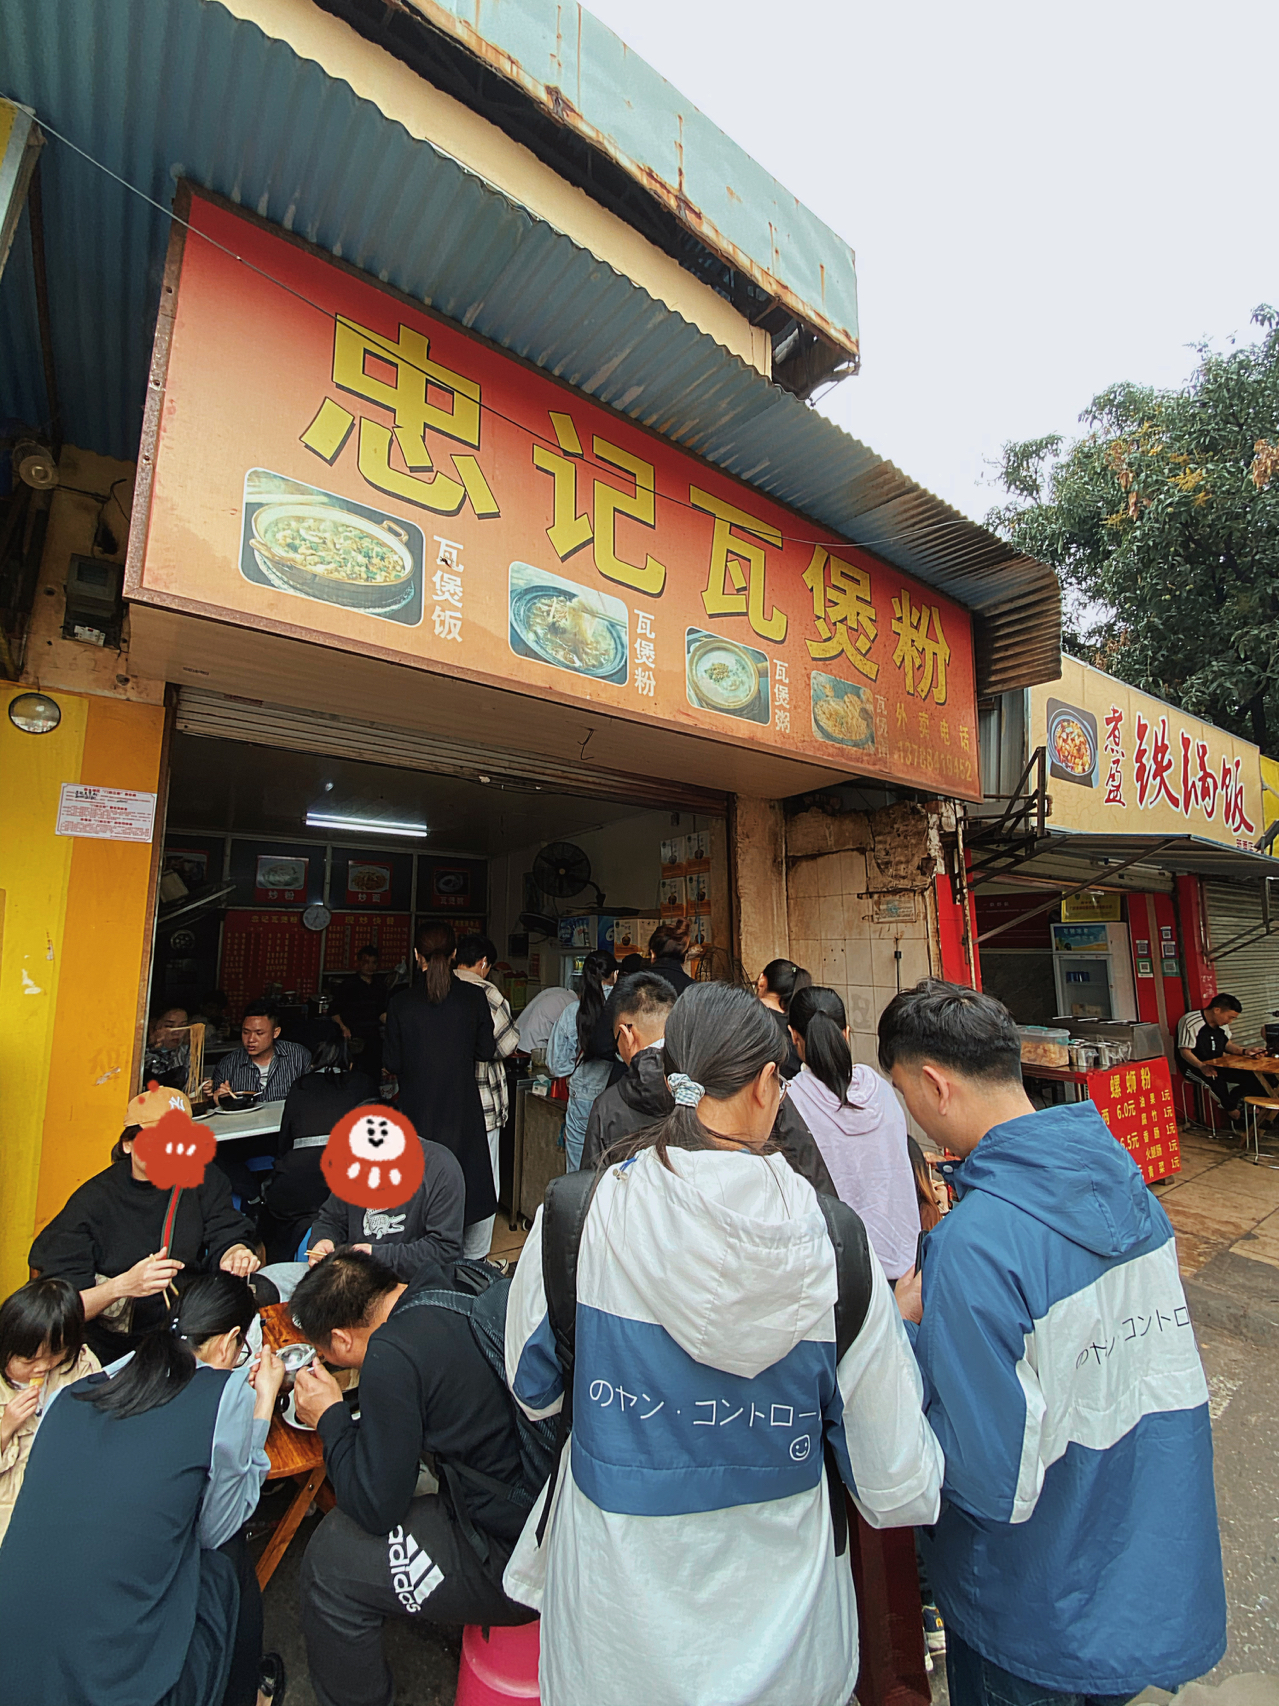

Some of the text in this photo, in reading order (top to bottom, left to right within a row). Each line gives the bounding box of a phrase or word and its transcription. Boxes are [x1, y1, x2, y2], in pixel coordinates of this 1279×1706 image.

[299, 313, 951, 706] 忠记瓦煲粉
[432, 535, 464, 643] 瓦煲饭
[634, 608, 656, 697] 瓦煲粉
[773, 659, 790, 734] 瓦煲粥
[896, 703, 970, 753] 外卖电话
[1134, 714, 1255, 834] 铁锅饭
[1110, 1066, 1151, 1098] 螺蛳粉
[1161, 1089, 1171, 1101] 1元
[1116, 1100, 1136, 1119] 6.0元
[1163, 1106, 1173, 1118] 1元
[1166, 1122, 1176, 1135] 1元
[1168, 1139, 1178, 1152] 1元
[1171, 1156, 1180, 1169] 1元
[388, 1524, 422, 1613] adidas
